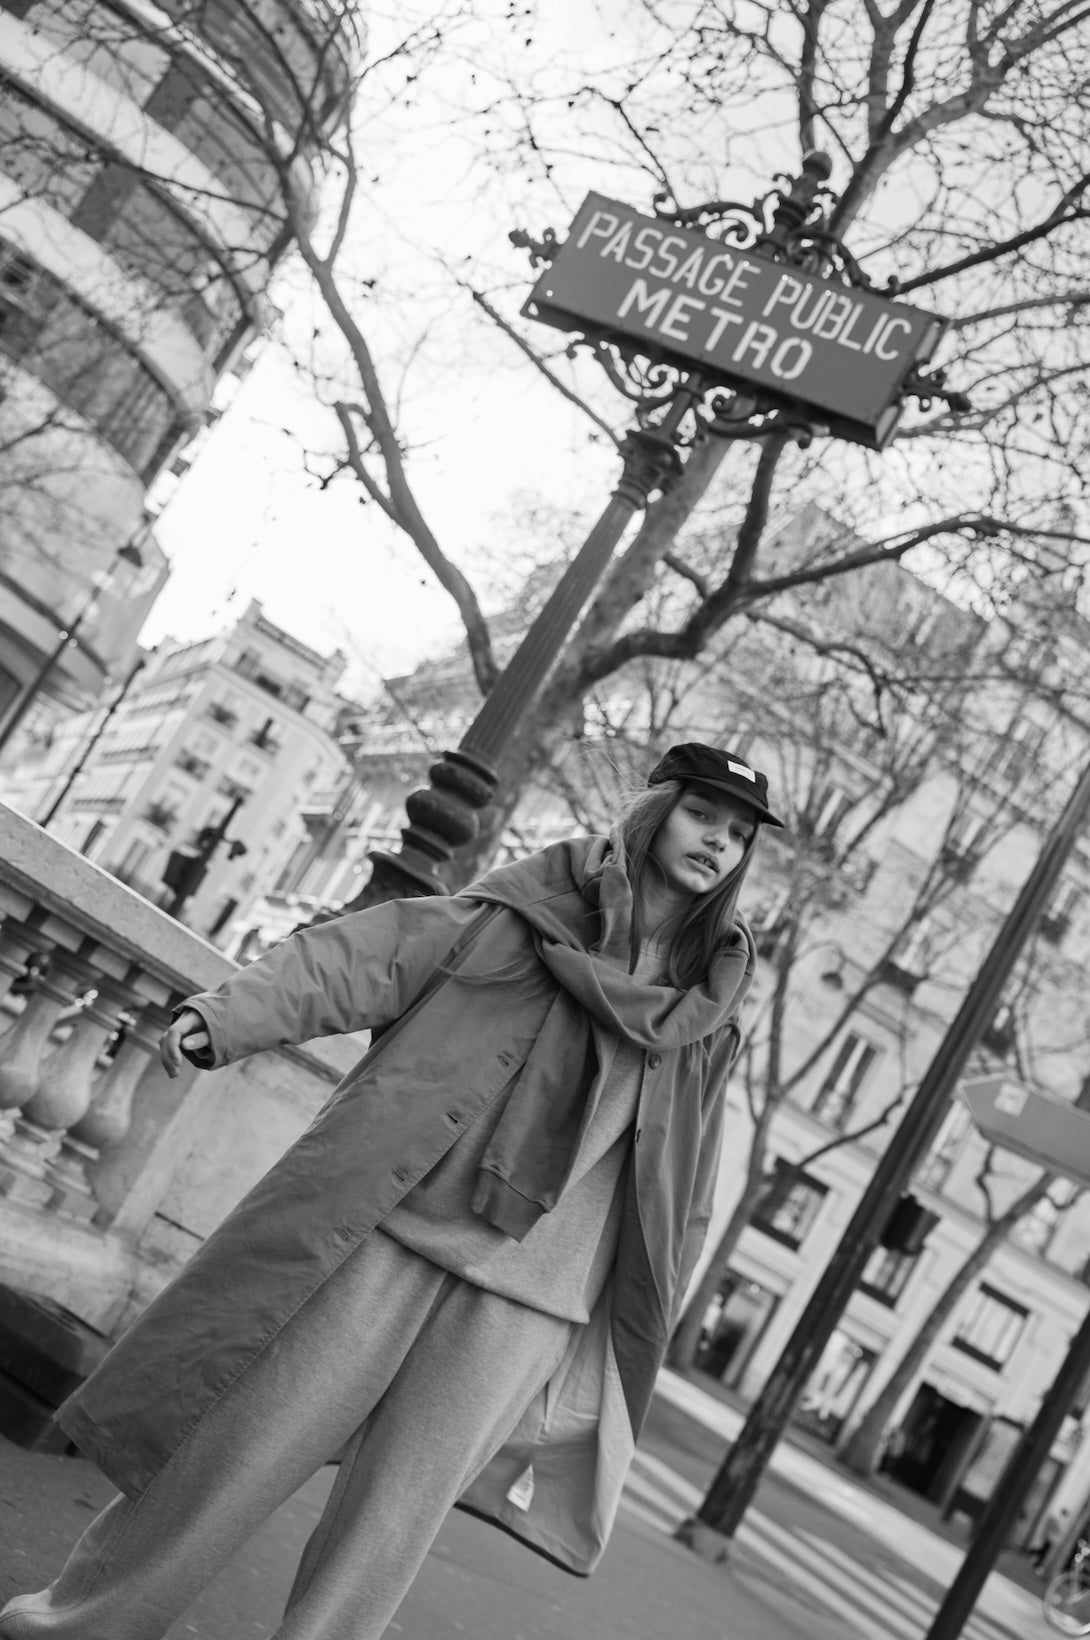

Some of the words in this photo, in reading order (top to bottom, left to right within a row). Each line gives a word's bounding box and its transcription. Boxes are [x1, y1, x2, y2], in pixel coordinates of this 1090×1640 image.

[576, 210, 762, 307] PASSAGE
[762, 274, 912, 361] PUBLIC
[616, 278, 813, 380] METRO
